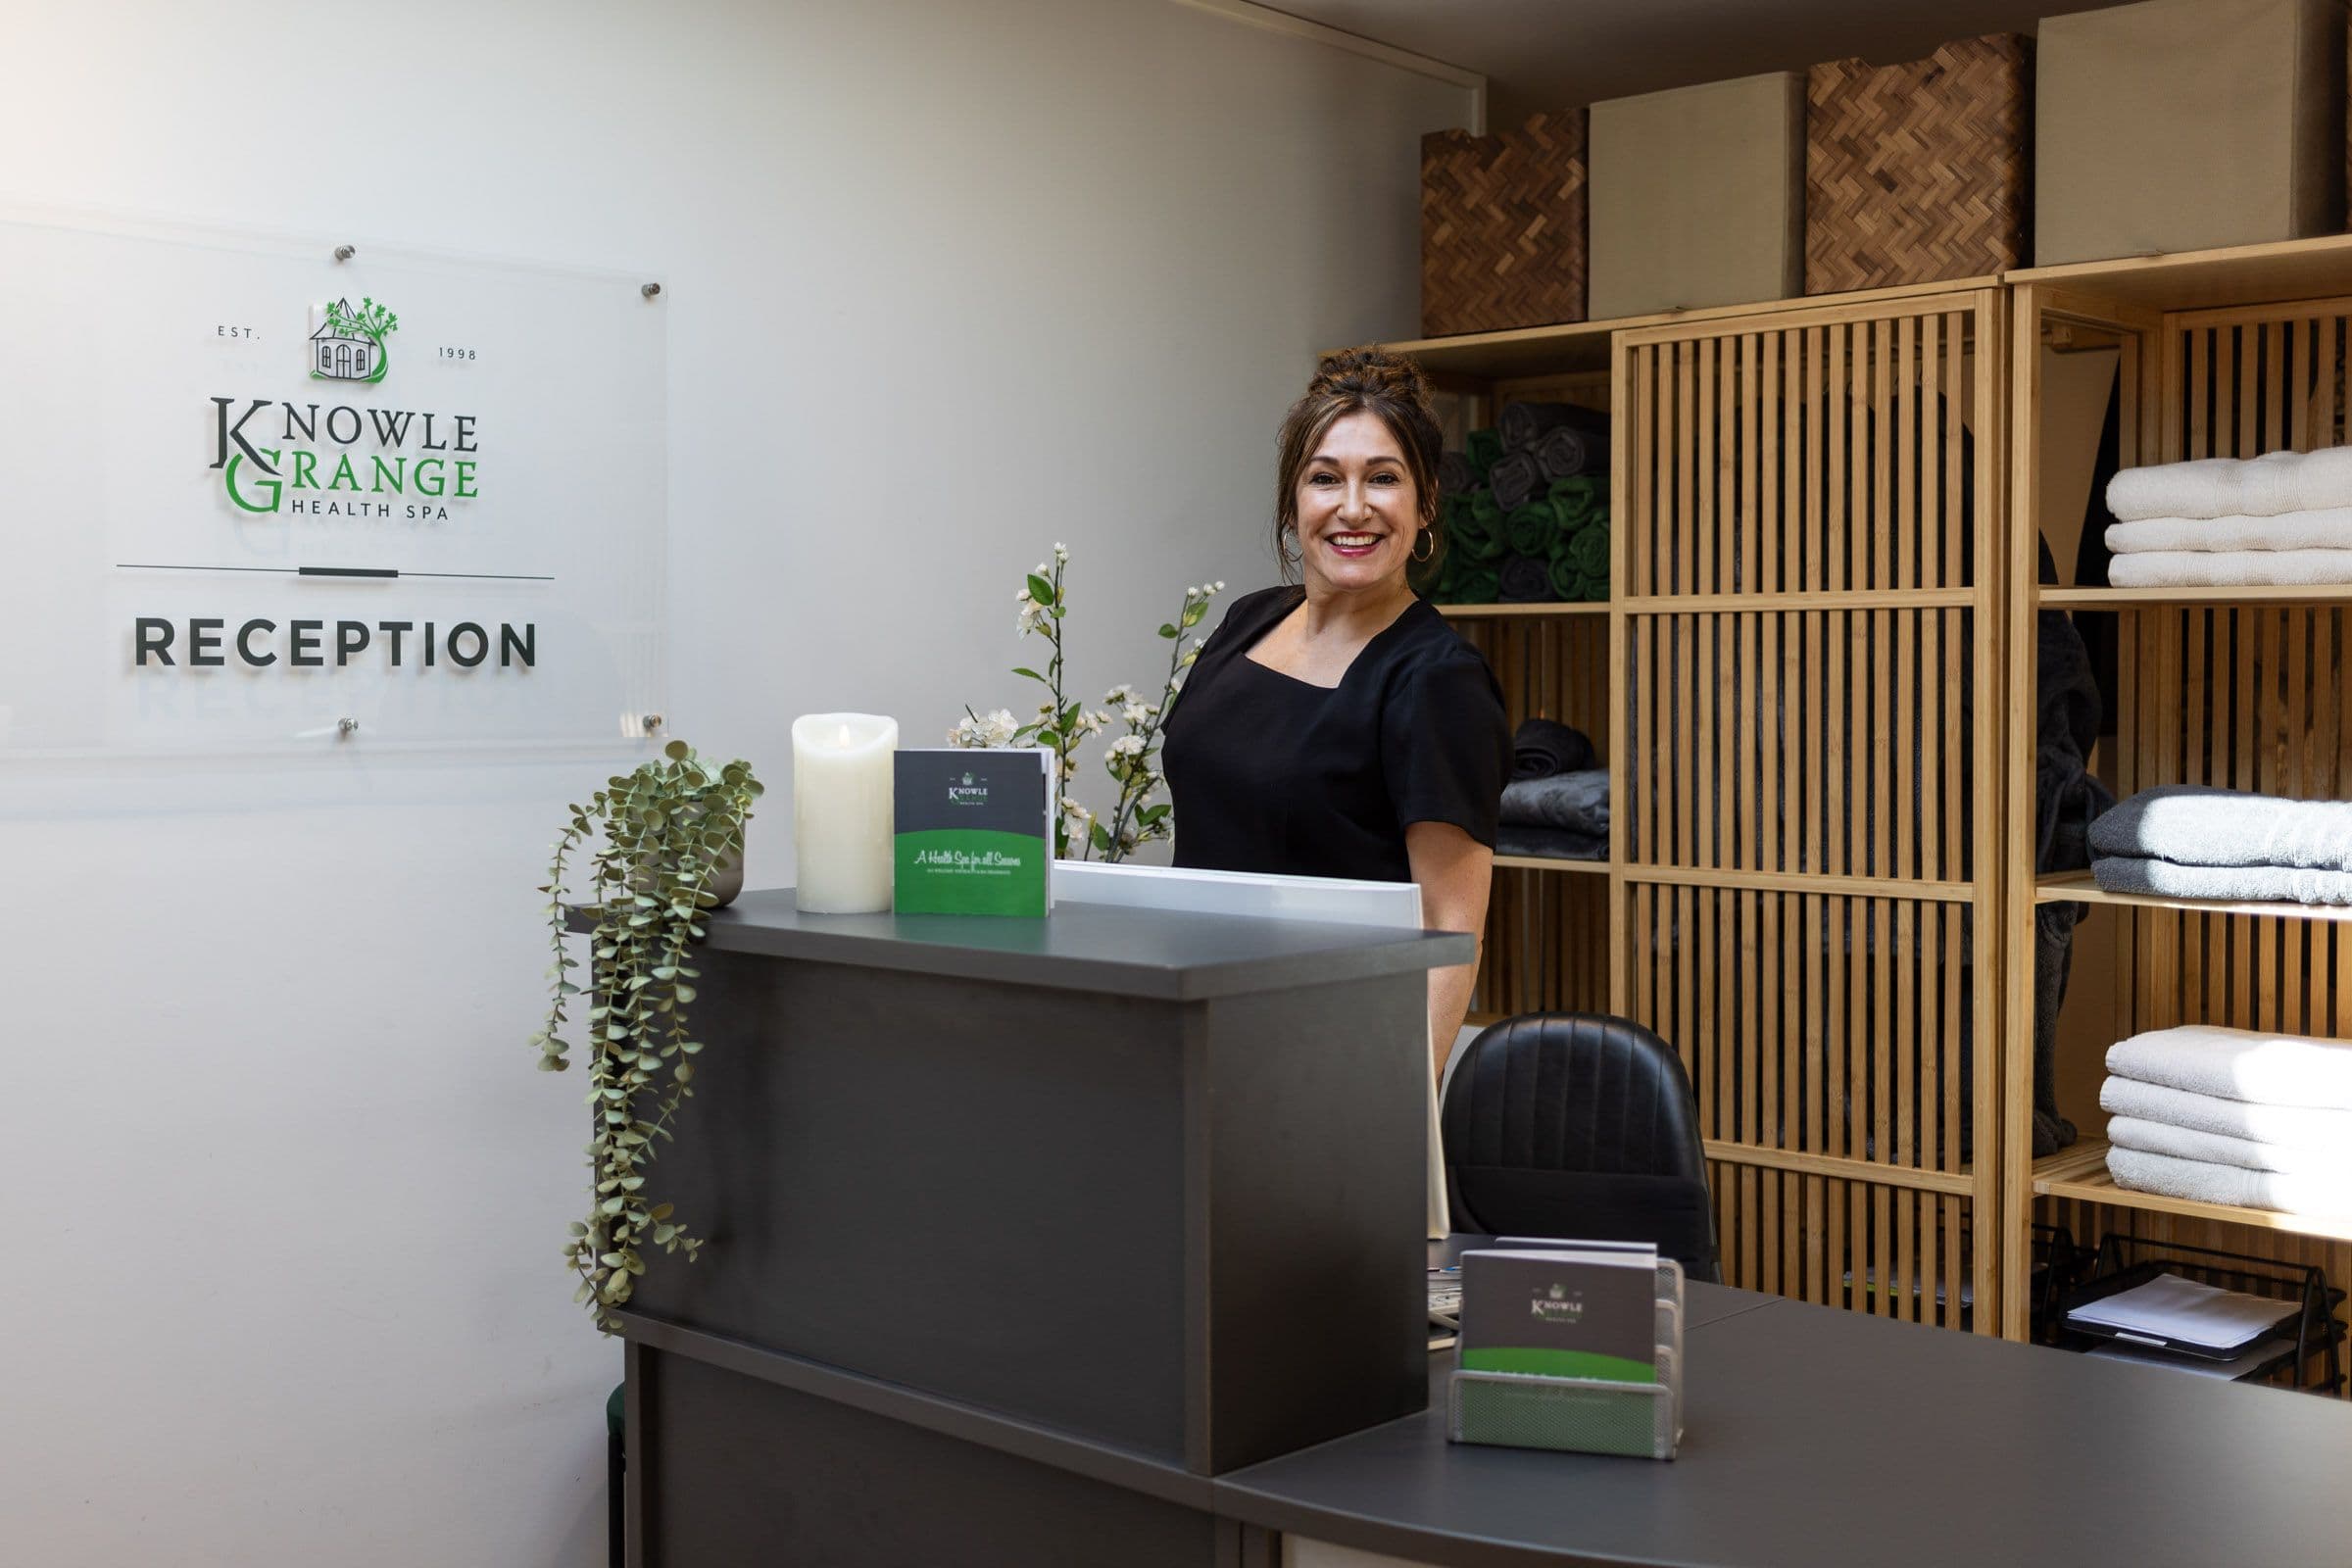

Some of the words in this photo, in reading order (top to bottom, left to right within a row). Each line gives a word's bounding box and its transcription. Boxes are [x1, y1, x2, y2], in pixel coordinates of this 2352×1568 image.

[218, 325, 261, 340] EST.
[439, 347, 476, 361] 1998
[209, 396, 478, 477] KNOWLE
[225, 447, 478, 514] GRANGE
[292, 499, 390, 517] HEALTH
[406, 505, 449, 520] SPA
[134, 616, 536, 668] RECEPTION
[949, 787, 988, 800] KNOWLE
[913, 850, 927, 864] A
